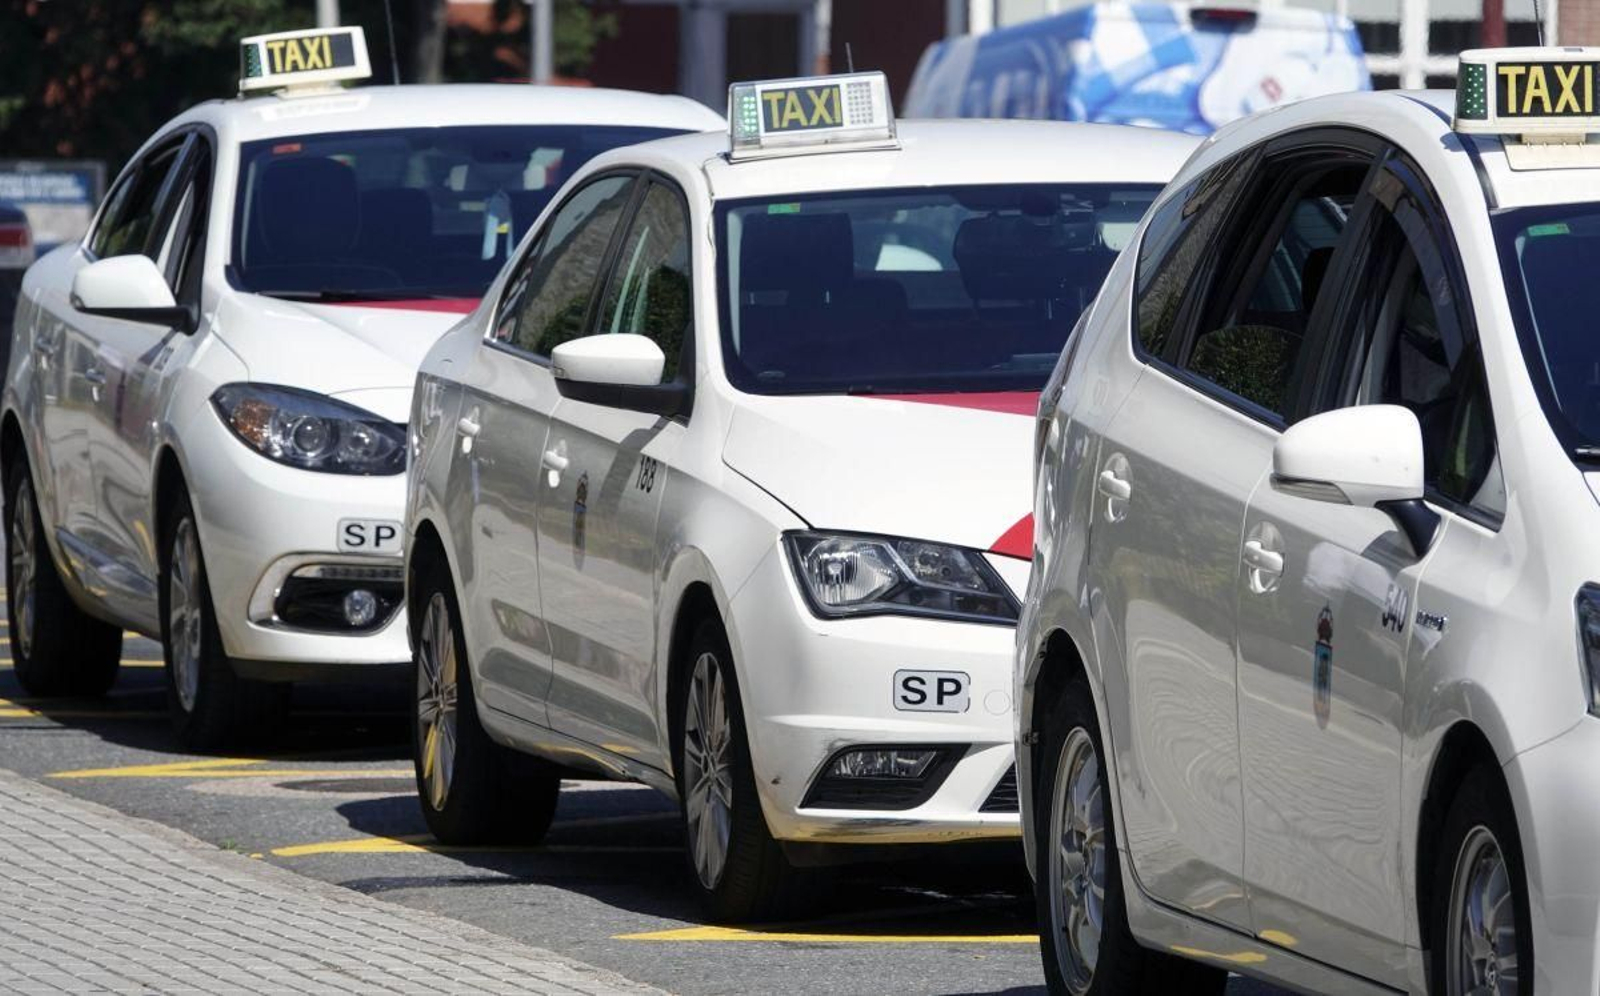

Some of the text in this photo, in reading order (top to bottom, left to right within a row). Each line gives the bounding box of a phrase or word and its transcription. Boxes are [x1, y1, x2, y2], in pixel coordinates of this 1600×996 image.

[267, 35, 332, 73] TAXI
[762, 87, 842, 129] TAXI
[1498, 64, 1594, 114] TAXI
[636, 454, 657, 493] 188
[344, 523, 396, 548] SP
[901, 676, 962, 706] SP
